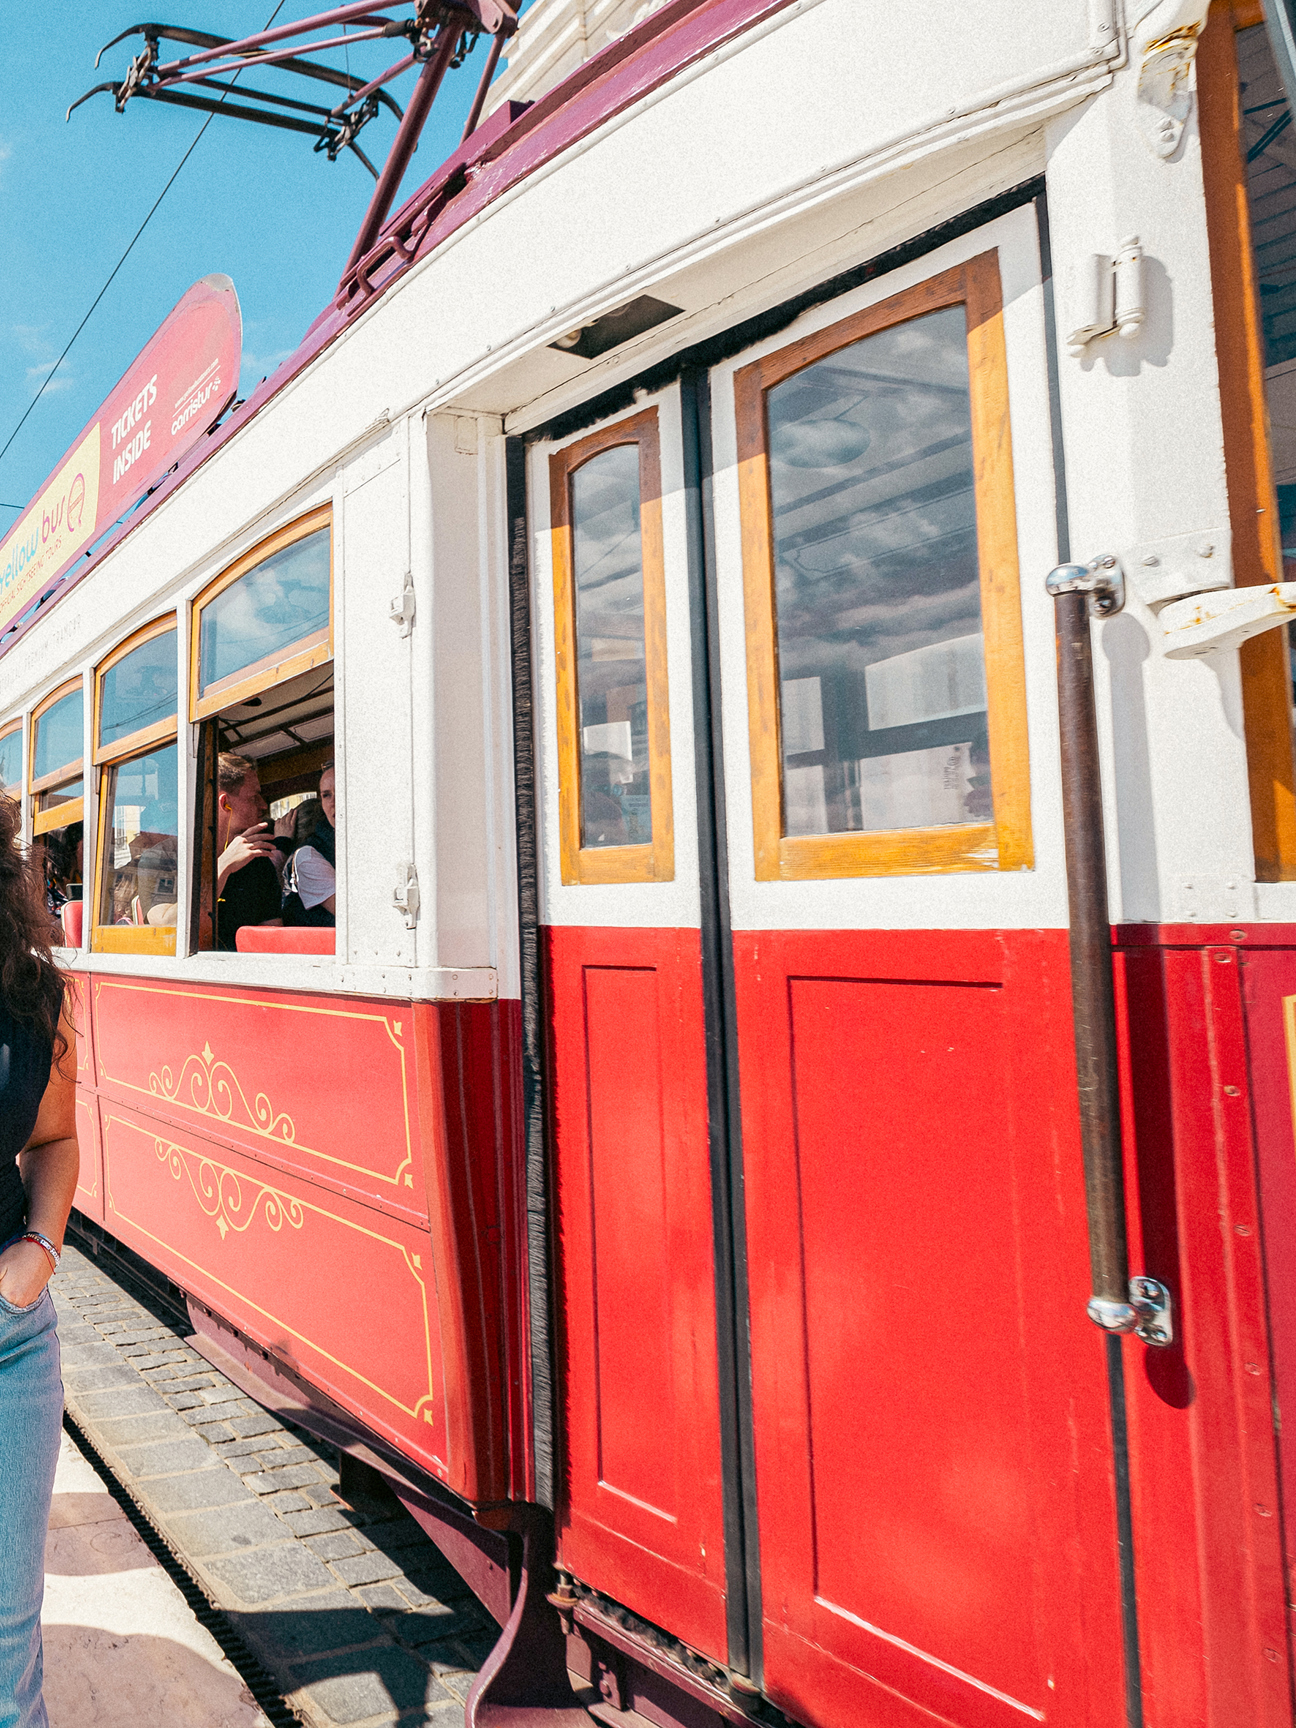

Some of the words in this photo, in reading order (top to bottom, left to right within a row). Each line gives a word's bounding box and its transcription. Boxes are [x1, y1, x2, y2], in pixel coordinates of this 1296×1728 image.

[111, 374, 157, 450] TICKETS
[112, 420, 152, 485] INSIDE
[41, 495, 66, 544] bus
